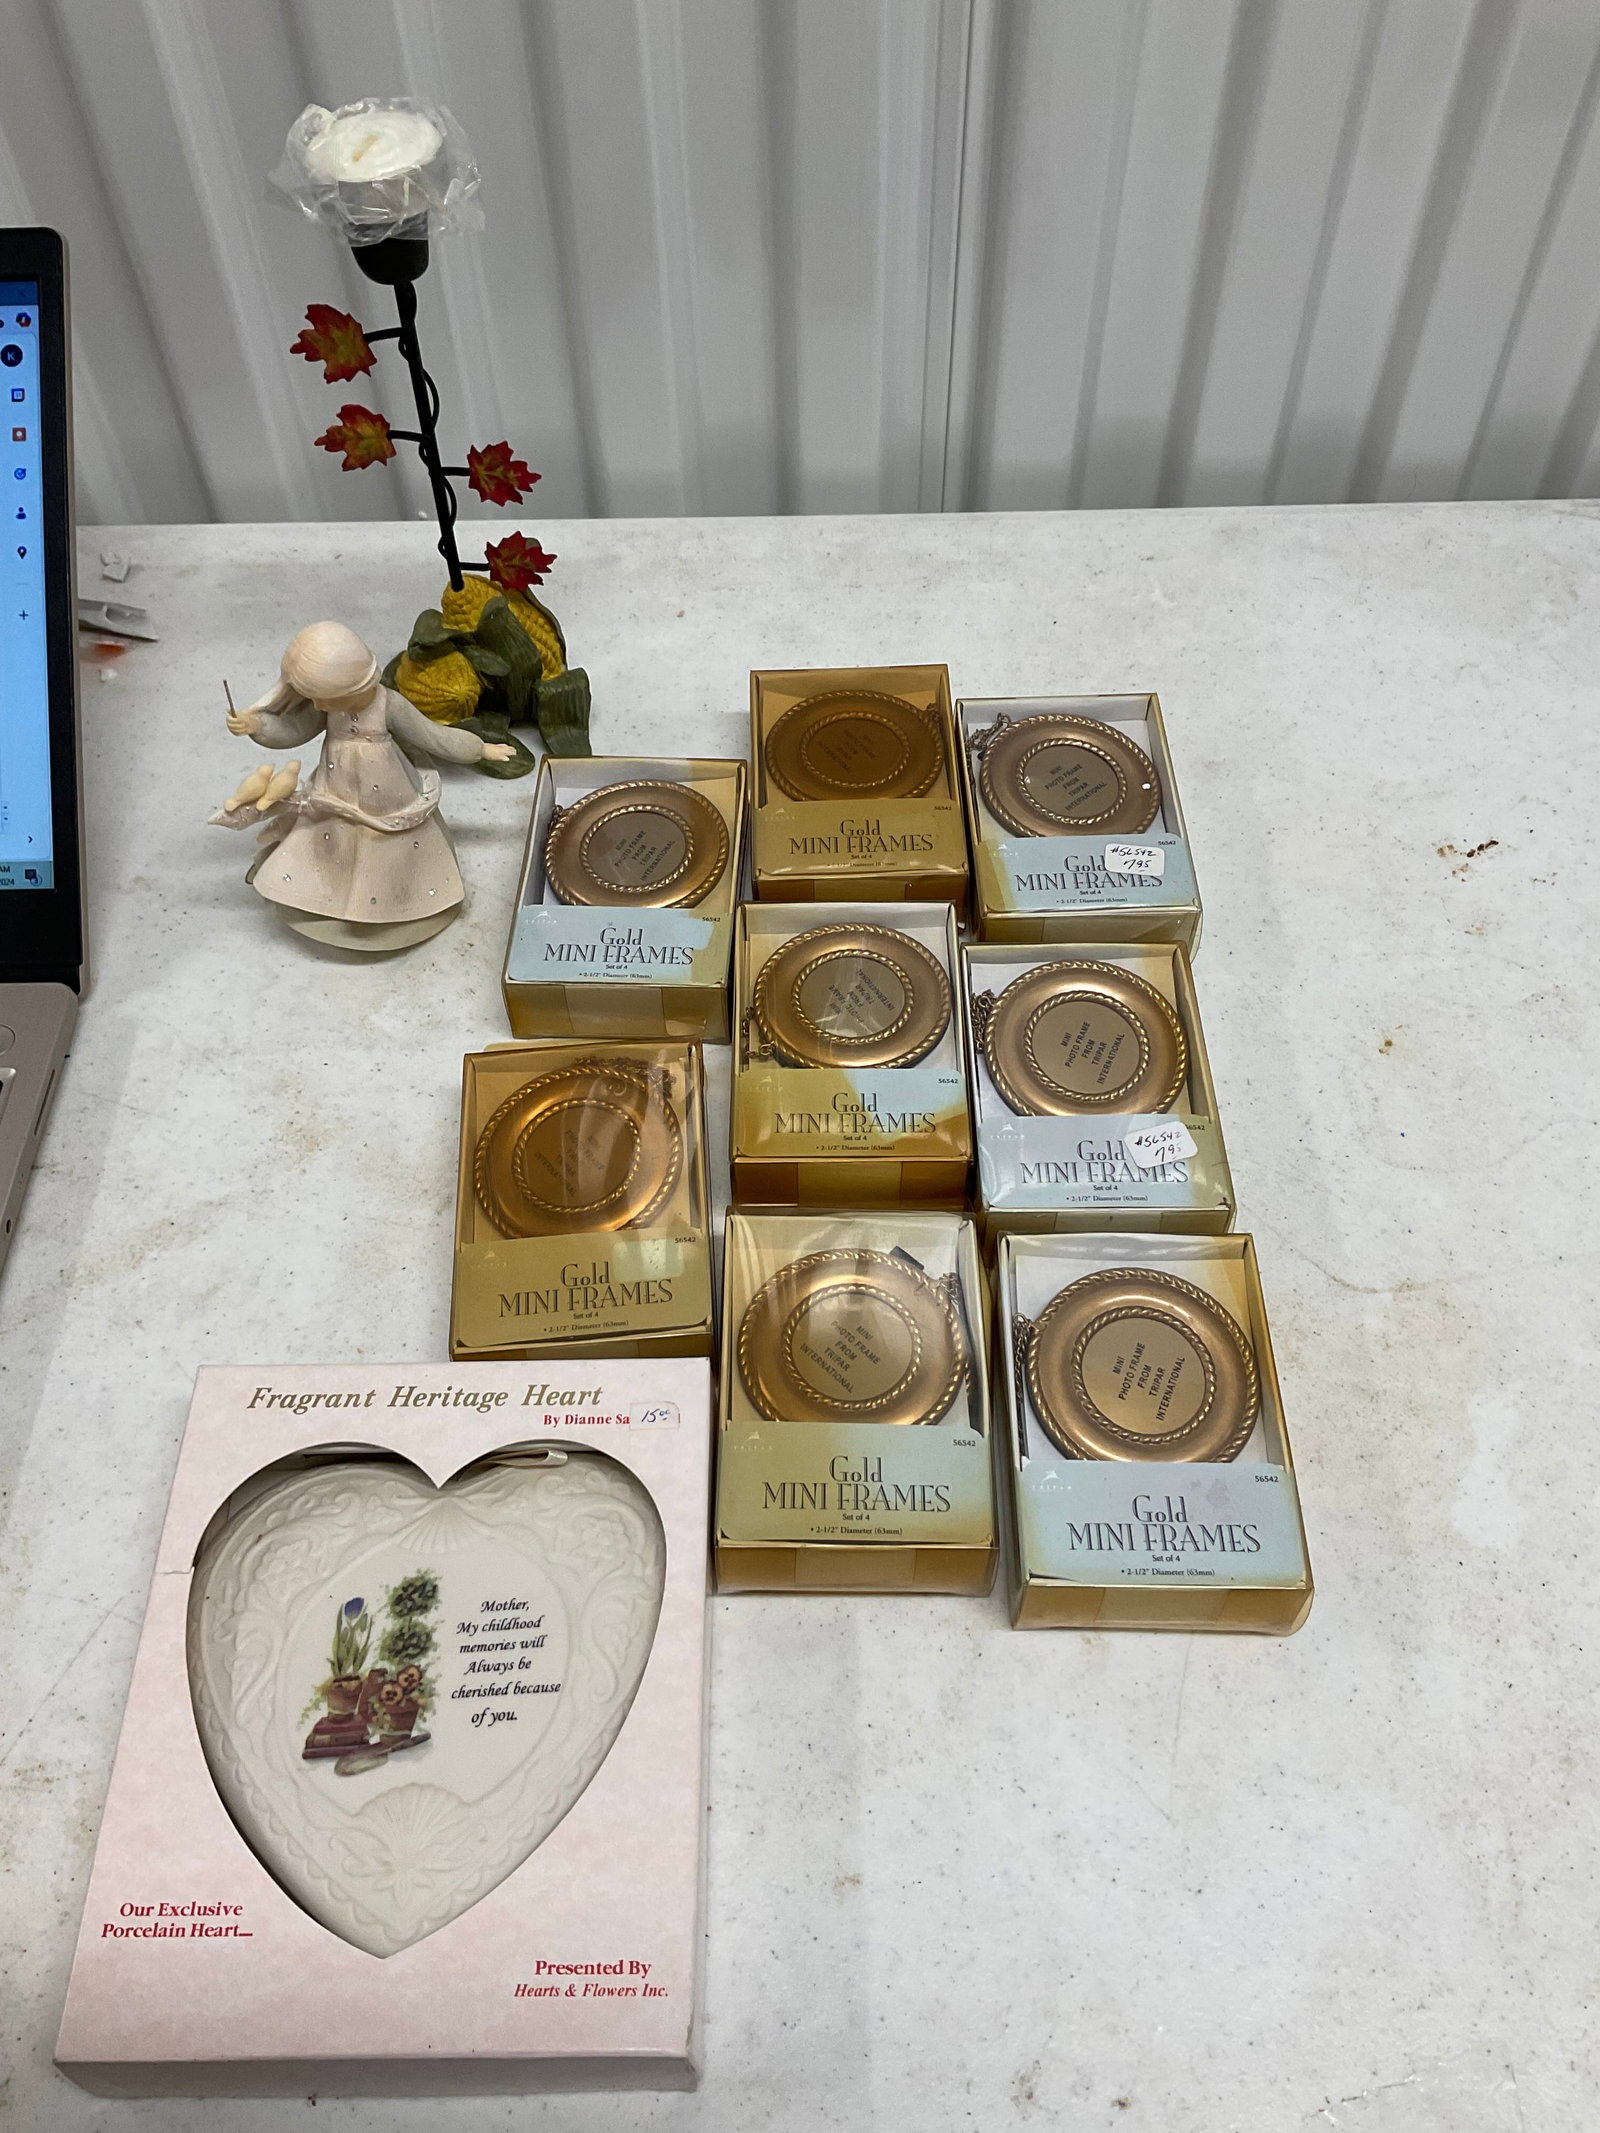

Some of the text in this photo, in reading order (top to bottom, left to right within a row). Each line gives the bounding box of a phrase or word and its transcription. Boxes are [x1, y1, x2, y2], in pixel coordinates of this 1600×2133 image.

[840, 819, 881, 836] Gold
[789, 834, 934, 855] MINI FRAMES
[1064, 855, 1106, 872] Gold
[1014, 872, 1163, 891] MINI FRAMES
[600, 927, 643, 946] Gold
[544, 943, 694, 965] MINI FRAMES
[1061, 1032, 1072, 1047] MINI
[1065, 1022, 1090, 1068] PHOTO FRAME
[1081, 1039, 1096, 1058] FROM
[1092, 1042, 1107, 1065] TRIPAR
[1096, 1034, 1124, 1084] INTERNATIONAL
[832, 1092, 878, 1112] Gold
[775, 1112, 936, 1134] MINI FRAMES
[1077, 1140, 1126, 1161] Gold
[1020, 1162, 1188, 1184] MINI FRAMES
[674, 1236, 696, 1244] 56542
[560, 1261, 610, 1288] Gold
[498, 1278, 673, 1318] MINI FRAMES
[831, 1320, 880, 1364] PHOTO FRAME
[856, 1326, 873, 1341] MINI
[824, 1347, 850, 1372] TRIPAR
[835, 1340, 857, 1360] FROM
[800, 1344, 854, 1394] INTERNATIONAL
[1112, 1356, 1126, 1374] MINI
[1118, 1342, 1146, 1400] PHOTO FRAME
[1138, 1364, 1152, 1389] FROM
[1148, 1368, 1166, 1396] TRIPAR
[1156, 1357, 1185, 1421] INTERNATIONAL
[246, 1384, 604, 1415] Fragrant Heritage Heart
[544, 1414, 560, 1428] By
[564, 1414, 612, 1425] Dianne
[953, 1439, 976, 1447] 56542
[829, 1455, 883, 1482] Gold
[1254, 1475, 1278, 1483] 56542
[762, 1482, 950, 1512] MINI FRAMES
[1131, 1494, 1188, 1522] Gold
[841, 1526, 872, 1534] Diameter
[874, 1528, 902, 1536] (63mm)
[1066, 1522, 1261, 1554] MINI FRAMES
[1152, 1554, 1164, 1562] Set
[1166, 1554, 1174, 1562] of
[1152, 1568, 1184, 1576] Diameter
[1186, 1568, 1216, 1576] (63mm)
[480, 1598, 530, 1612] Mother,
[456, 1615, 545, 1636] My childhood
[460, 1634, 548, 1654] memories will
[464, 1656, 532, 1675] Always be
[451, 1681, 561, 1699] cherished because
[471, 1706, 518, 1728] of you.
[120, 1900, 243, 1916] Our Exclusive
[101, 1922, 186, 1938] Porcelain
[534, 1960, 652, 1978] Presented By
[514, 1983, 669, 1998] Hearts & Flowers Inc.
